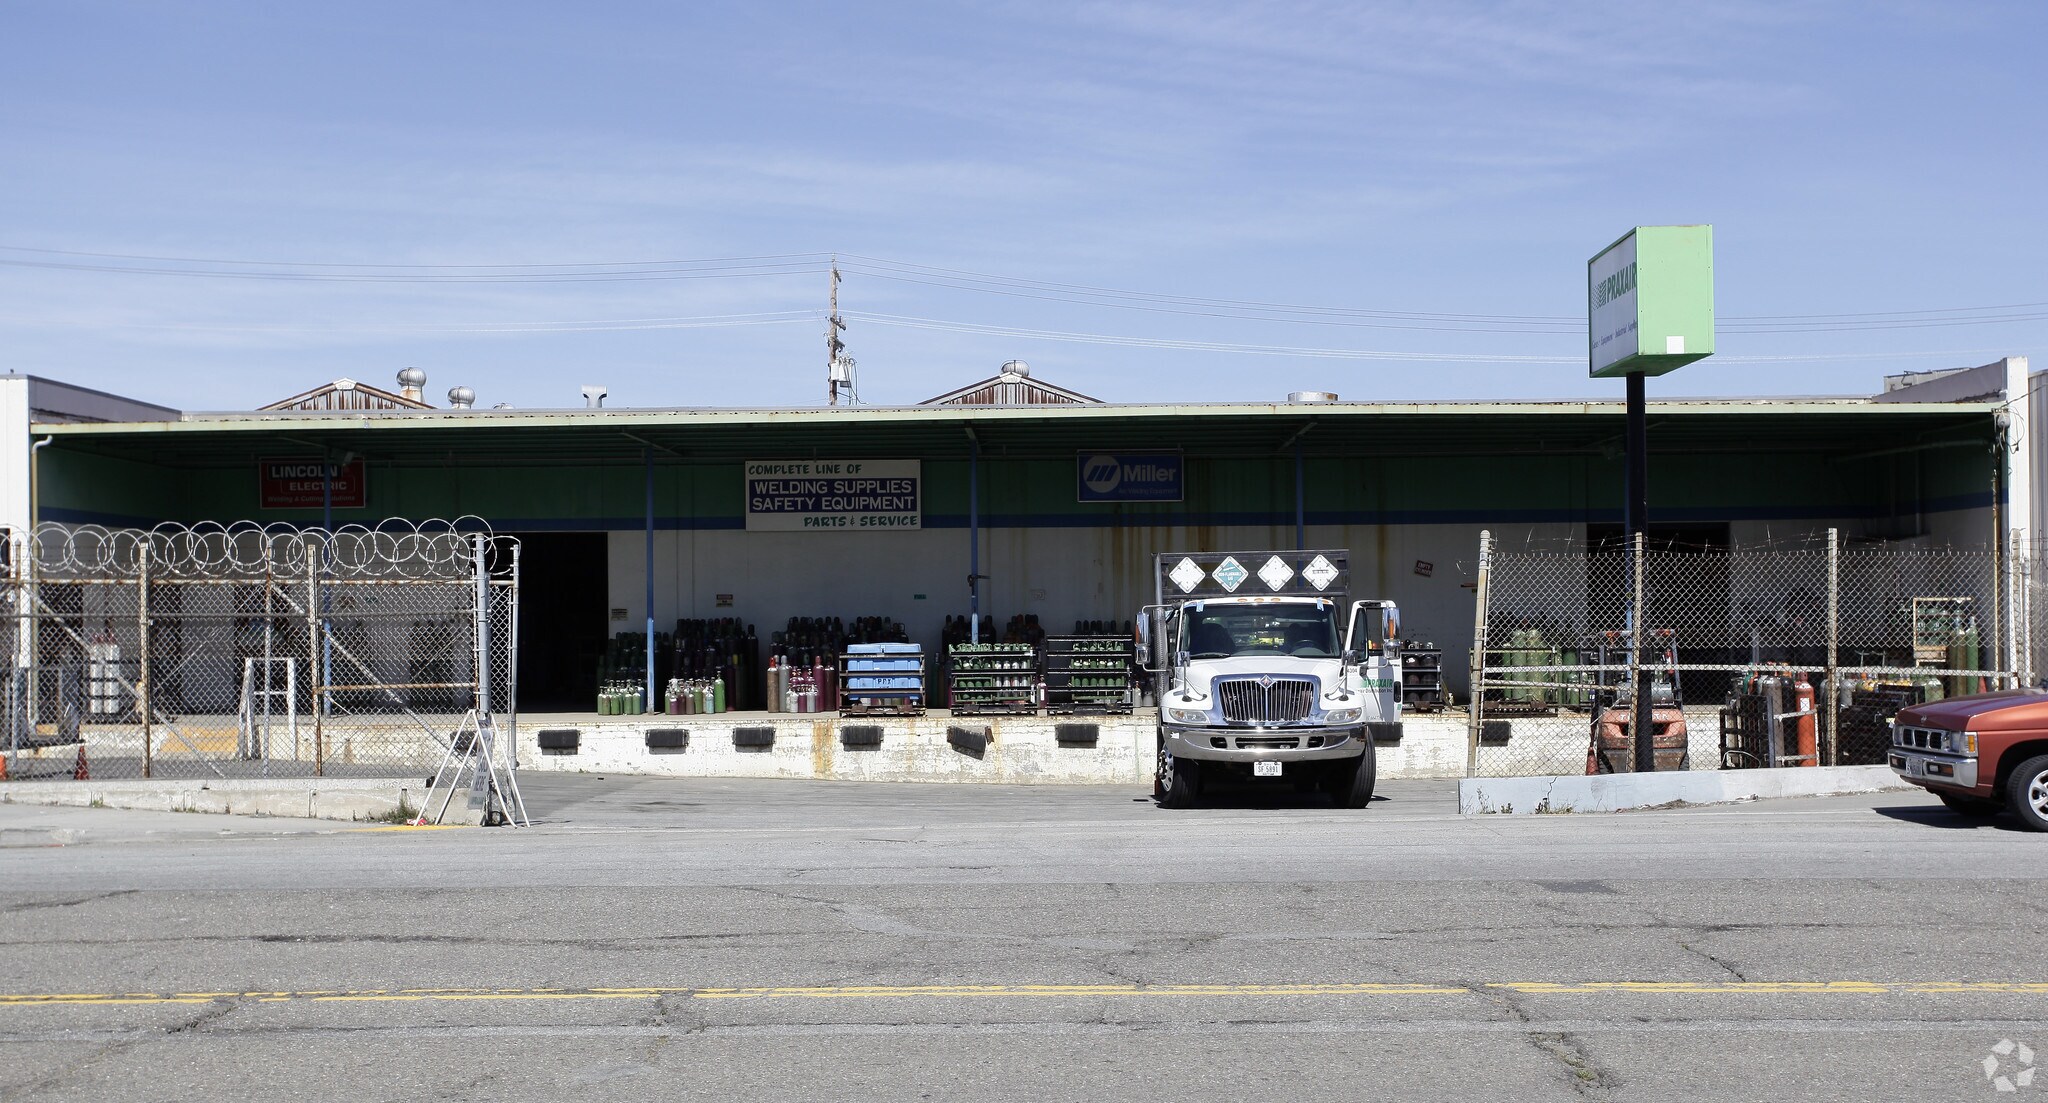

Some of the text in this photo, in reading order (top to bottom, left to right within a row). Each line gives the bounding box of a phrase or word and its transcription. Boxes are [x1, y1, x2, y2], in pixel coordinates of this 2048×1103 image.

[1606, 261, 1637, 303] PRAXAIR
[271, 465, 338, 478] LINCOLN
[748, 463, 862, 475] COMPLETE LINE OF
[1123, 464, 1177, 482] Miller
[289, 481, 347, 491] ELECTRIC
[754, 480, 912, 495] WELDING SUPPLIES
[752, 496, 914, 511] SAFETY EQUIPMENT
[804, 515, 918, 527] PARTS & SERVICE
